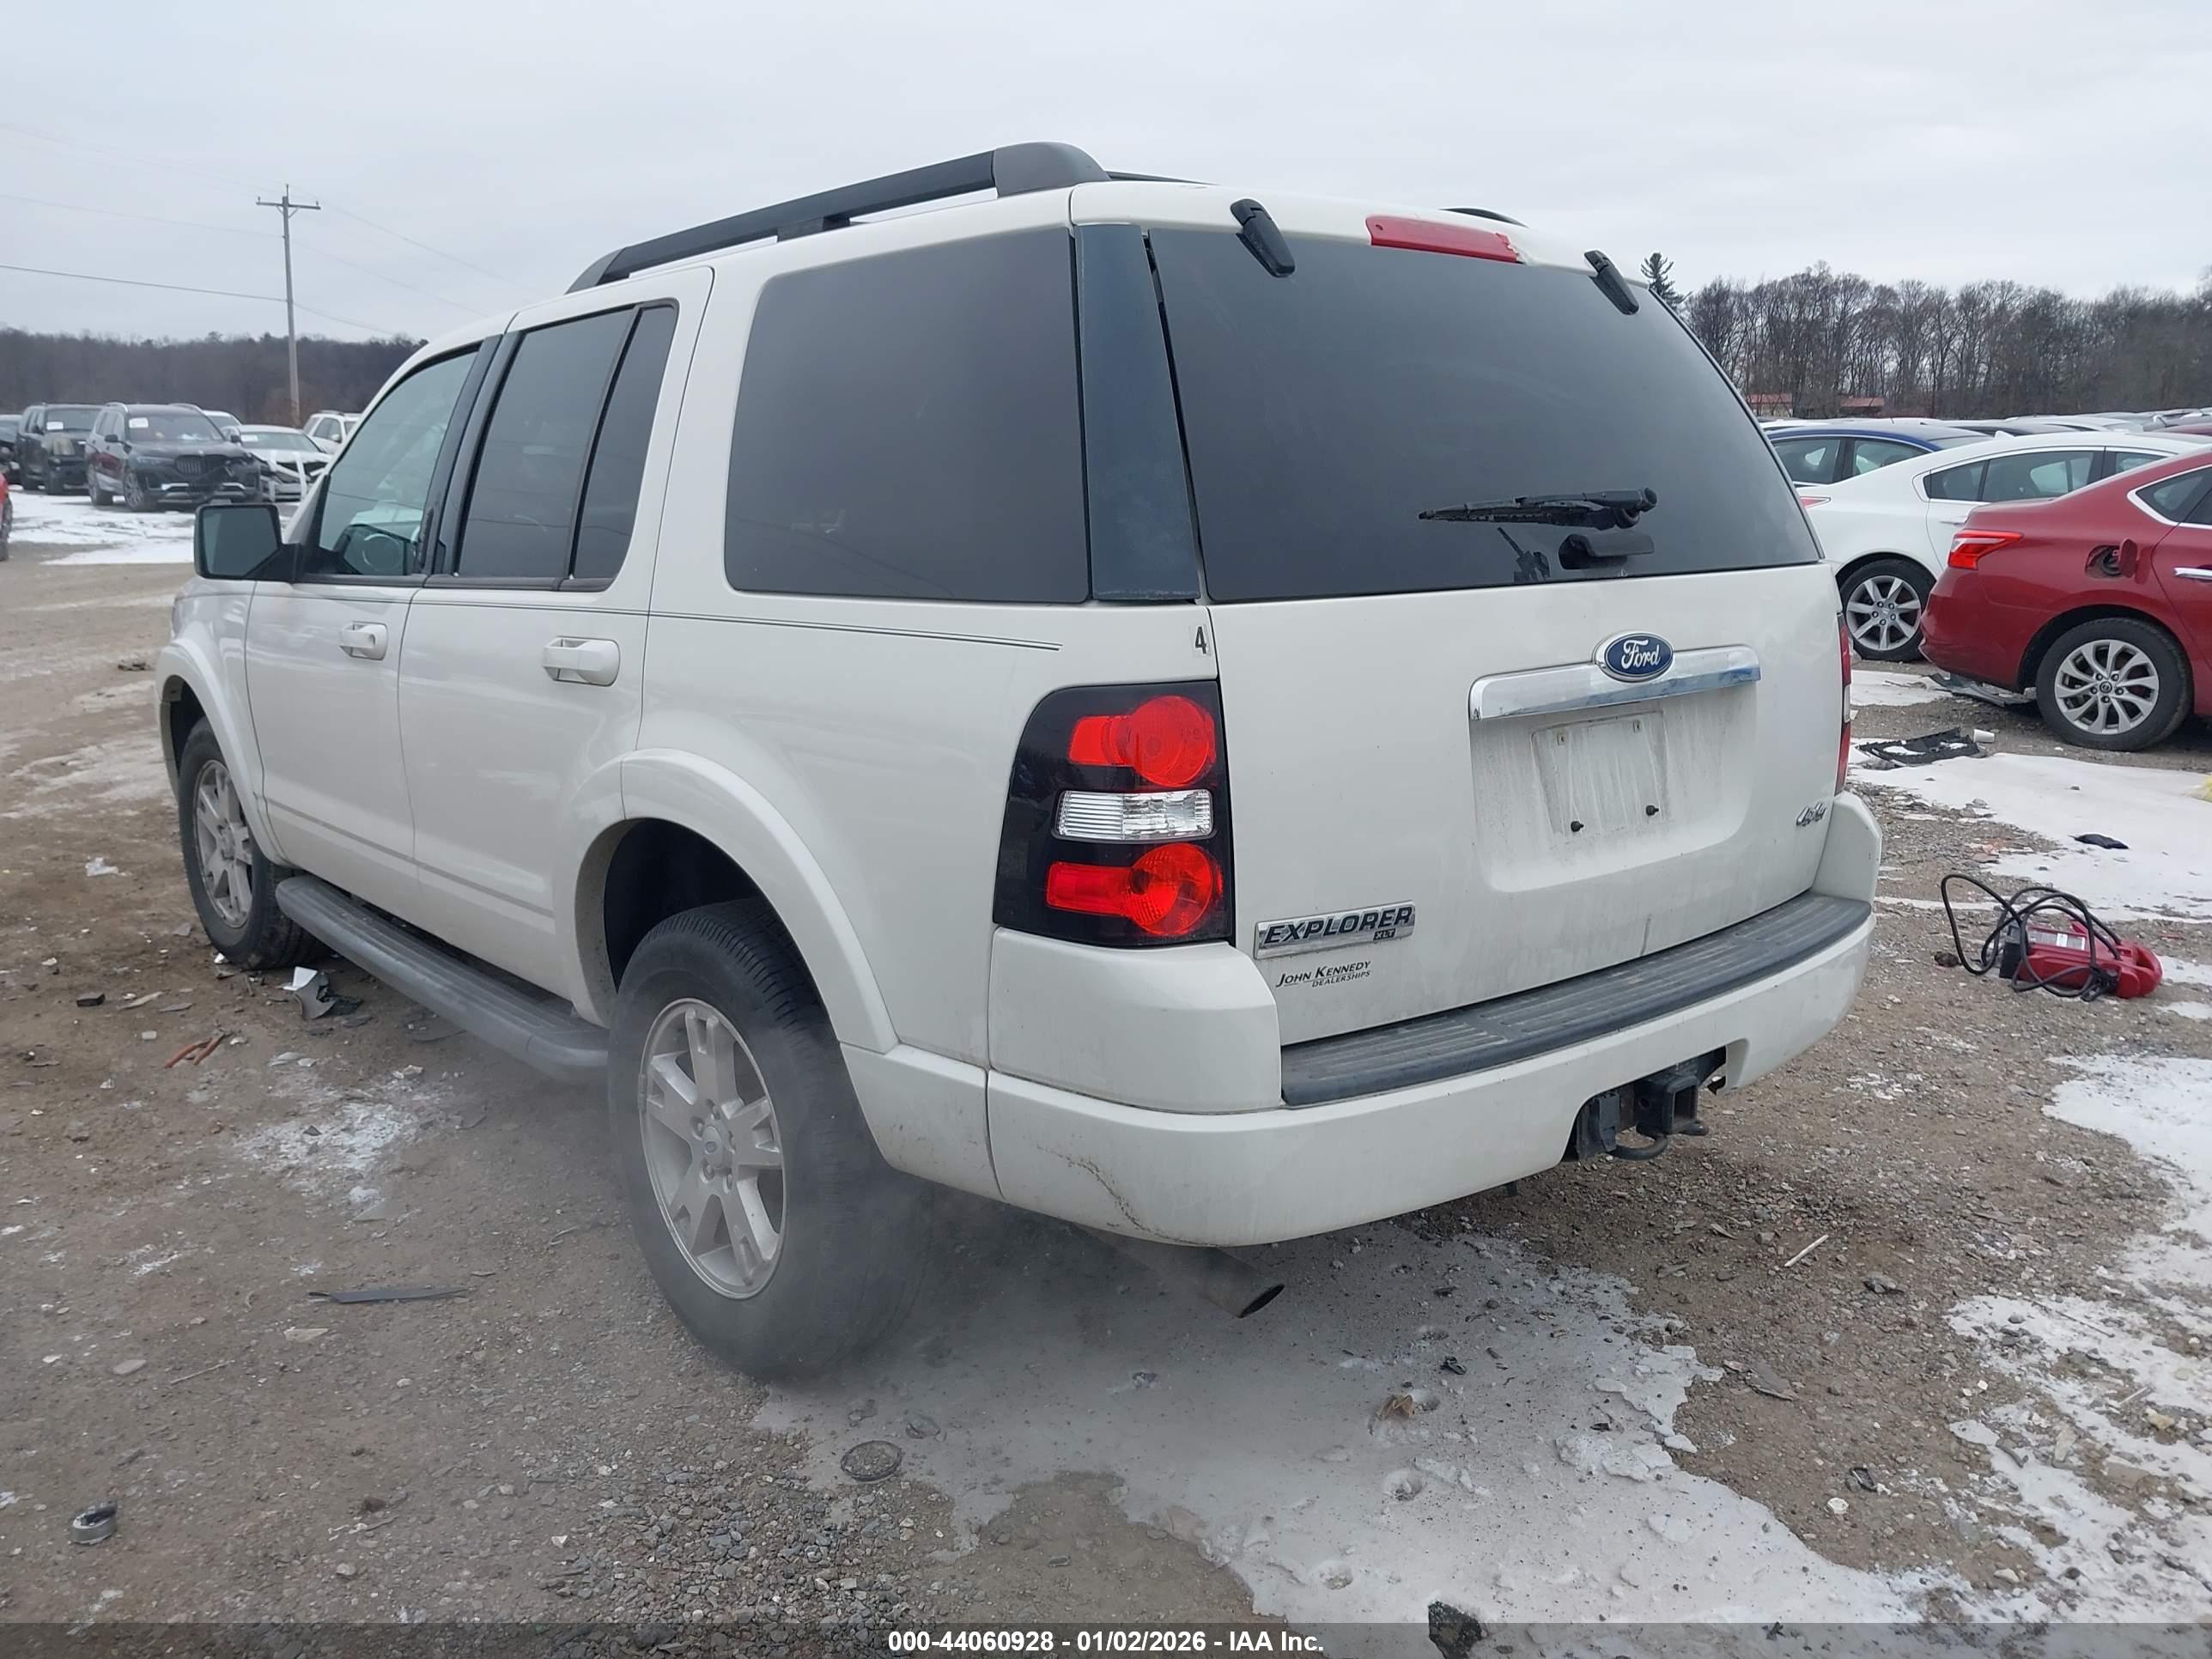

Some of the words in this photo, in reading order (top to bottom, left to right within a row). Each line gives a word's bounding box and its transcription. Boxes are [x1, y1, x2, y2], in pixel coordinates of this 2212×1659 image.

[1194, 625, 1207, 654] 4
[1620, 639, 1661, 670] Ford
[1263, 906, 1413, 945] EXPLORER
[1375, 929, 1395, 940] XLT
[1275, 971, 1312, 988] JOHN
[1315, 961, 1371, 979] KENNEDY
[1311, 970, 1370, 988] DEALERSHIPS
